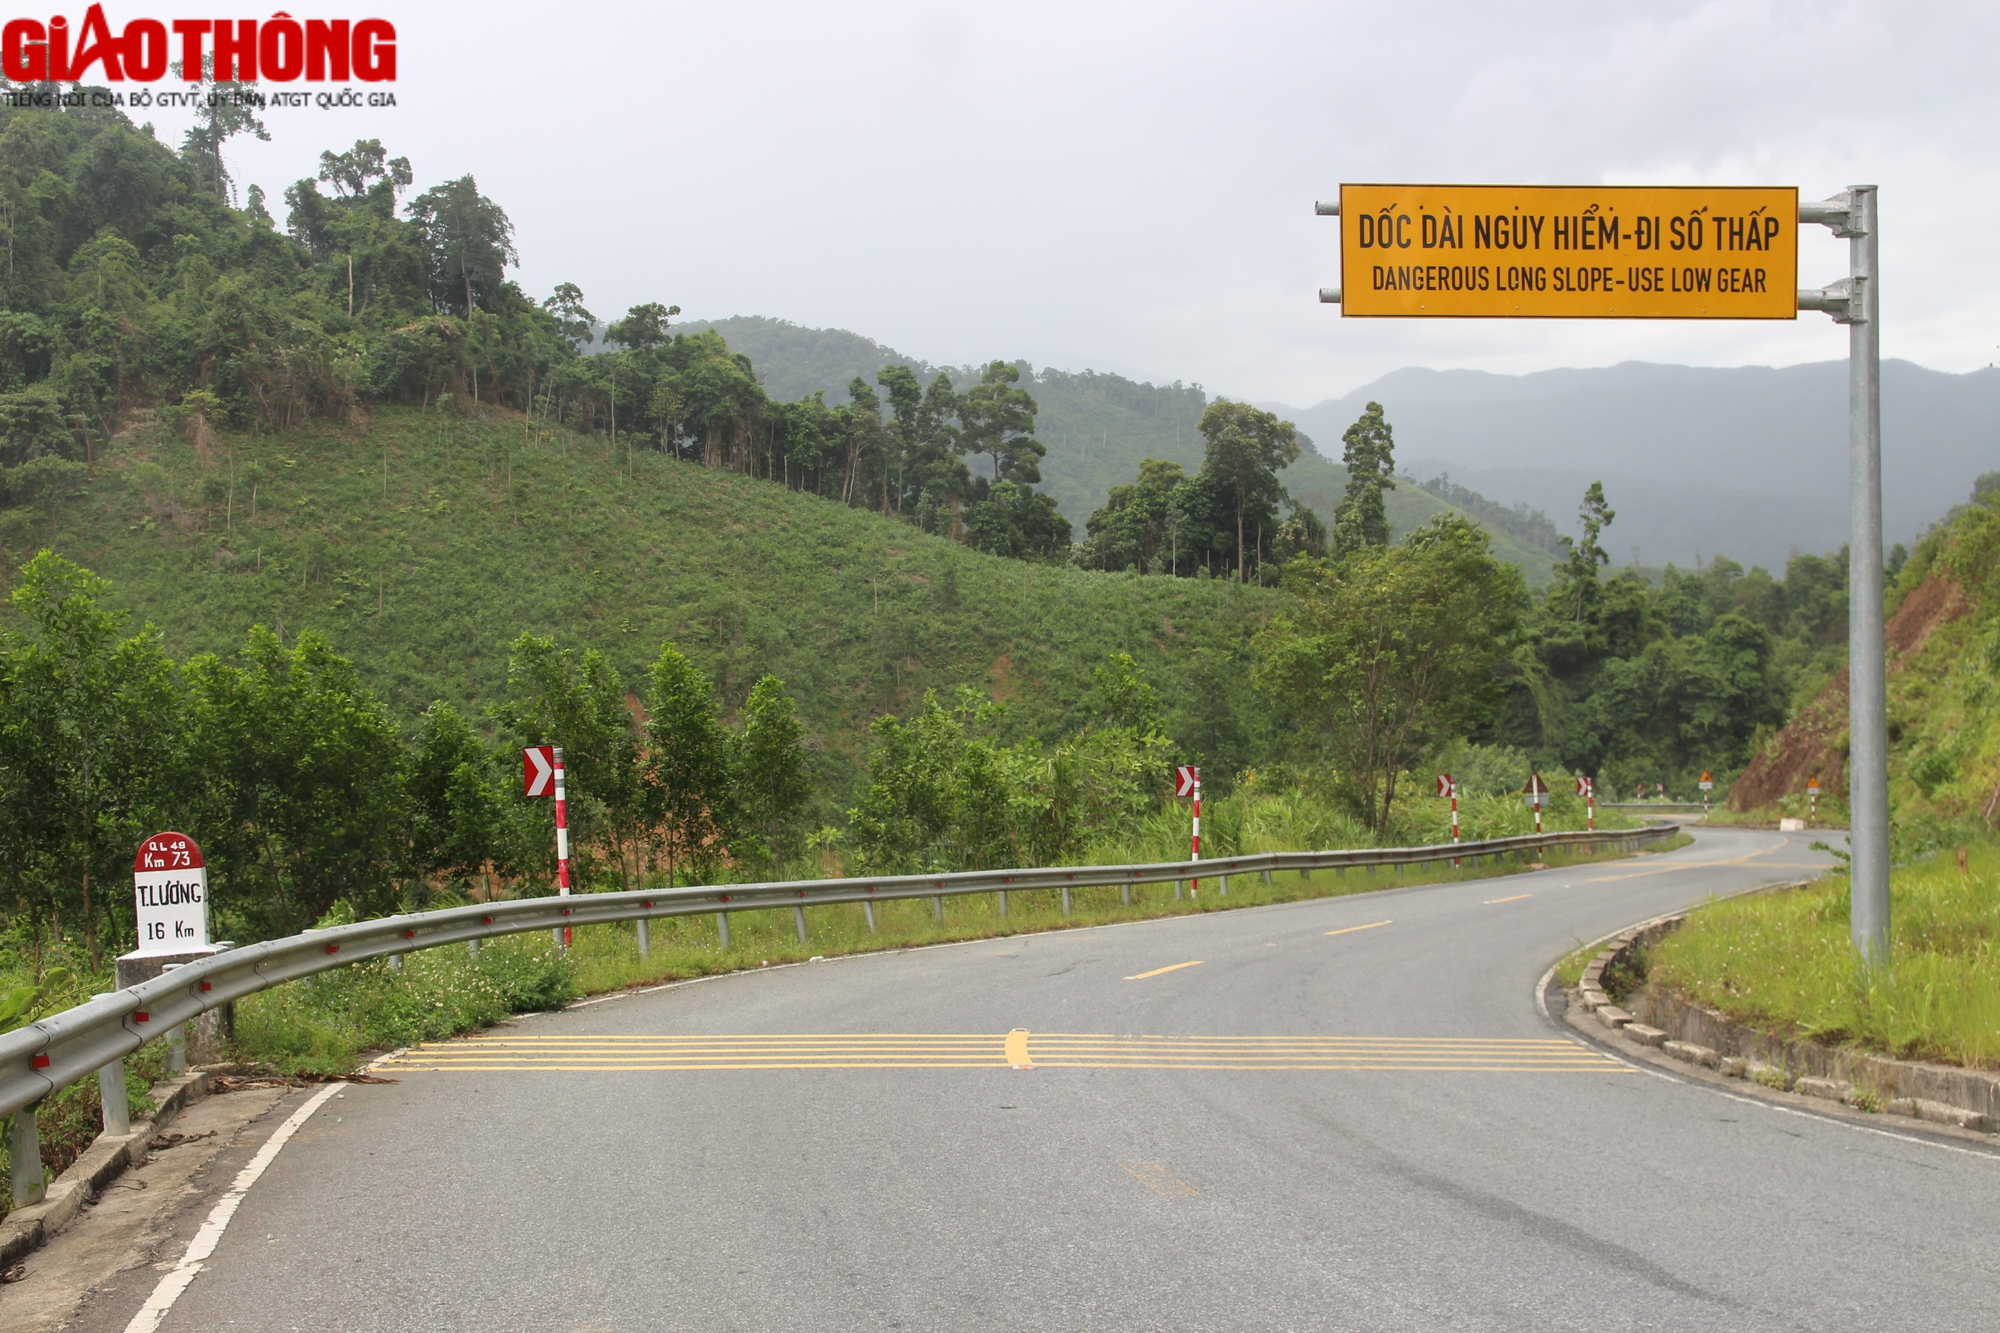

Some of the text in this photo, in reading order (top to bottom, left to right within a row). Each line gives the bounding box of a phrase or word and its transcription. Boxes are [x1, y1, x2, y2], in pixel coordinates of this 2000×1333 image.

[1359, 203, 1412, 249] DỐC
[1422, 206, 1463, 249] DÀI
[1475, 215, 1545, 250] NGUY
[1670, 206, 1708, 251] SỐ
[1712, 206, 1780, 251] THẤP
[1373, 265, 1490, 291] DANGEROUS
[1497, 266, 1546, 291] LONG
[1672, 267, 1712, 292] LOW
[1717, 268, 1766, 293] GEAR
[144, 851, 190, 868] Km 73
[137, 880, 202, 907] T.LƯƠNG
[148, 922, 165, 940] 16
[175, 920, 194, 938] Km
